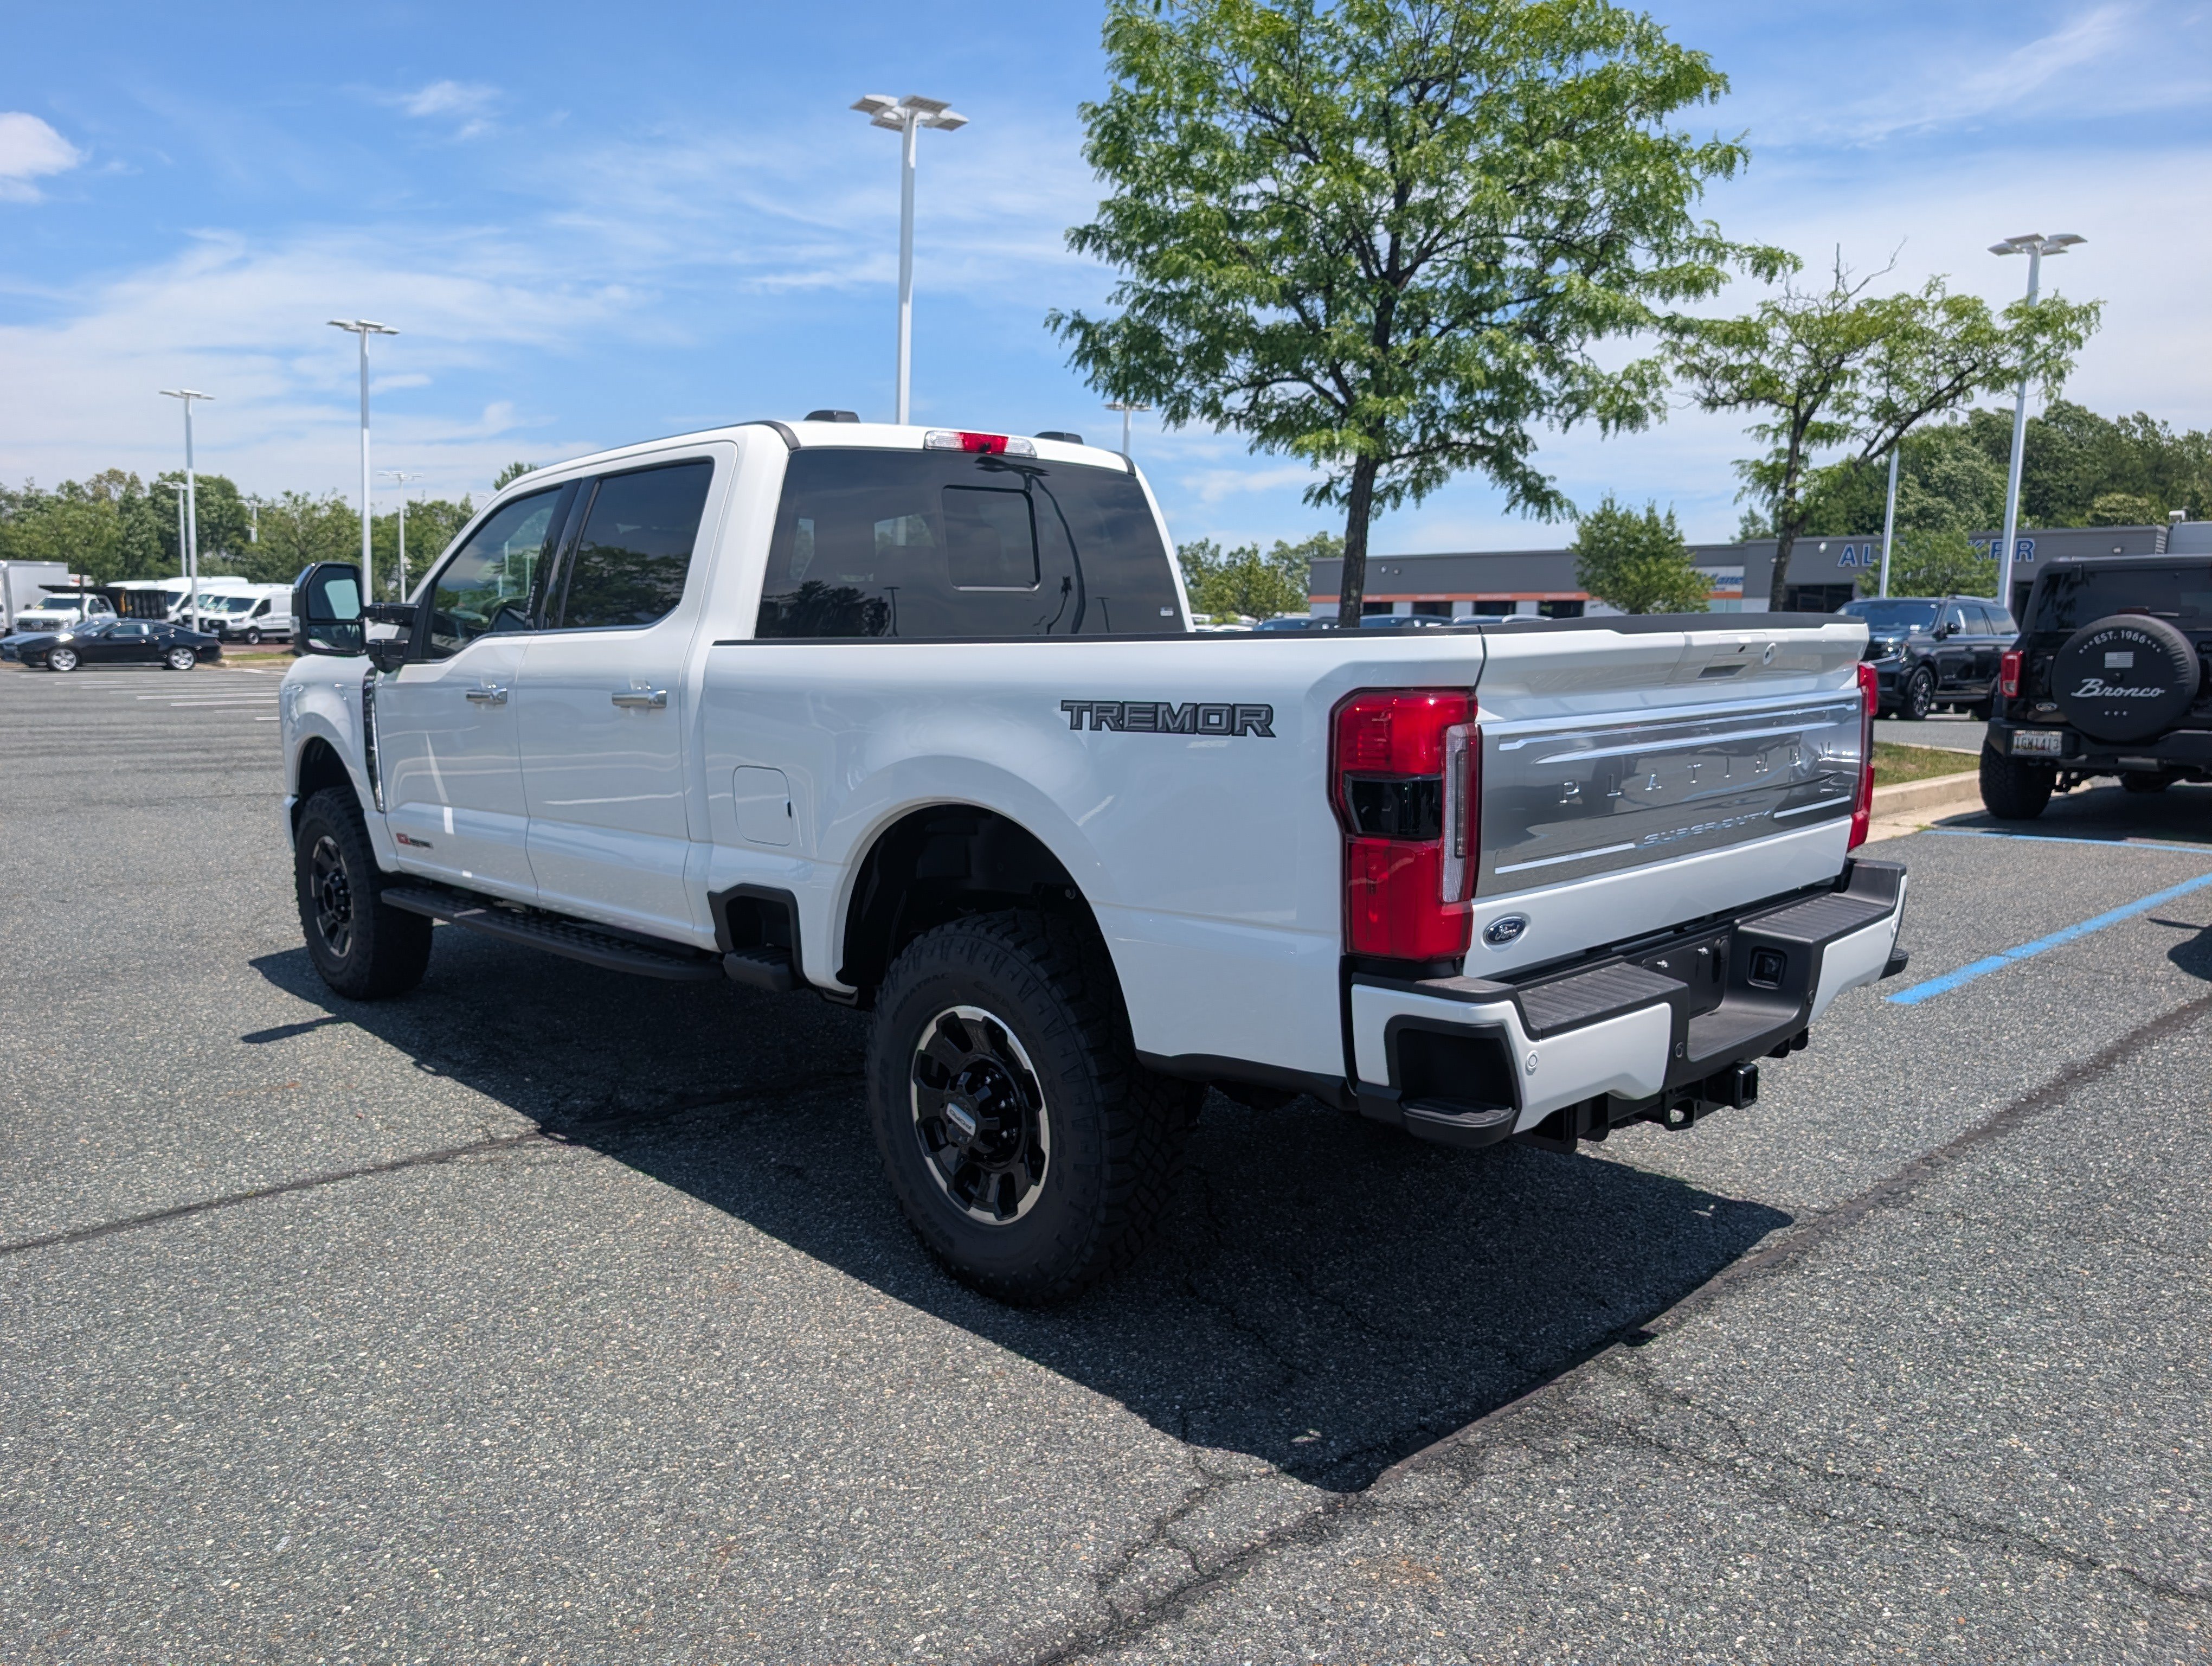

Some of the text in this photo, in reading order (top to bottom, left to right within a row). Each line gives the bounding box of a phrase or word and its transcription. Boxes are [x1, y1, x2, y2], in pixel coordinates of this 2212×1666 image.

[2093, 629, 2147, 645] EST. 1966
[2070, 677, 2166, 698] Bronco
[1060, 700, 1277, 738] TREMOR
[1559, 741, 1832, 804] PLATINUM
[1643, 810, 1772, 845] SUPER DUTY
